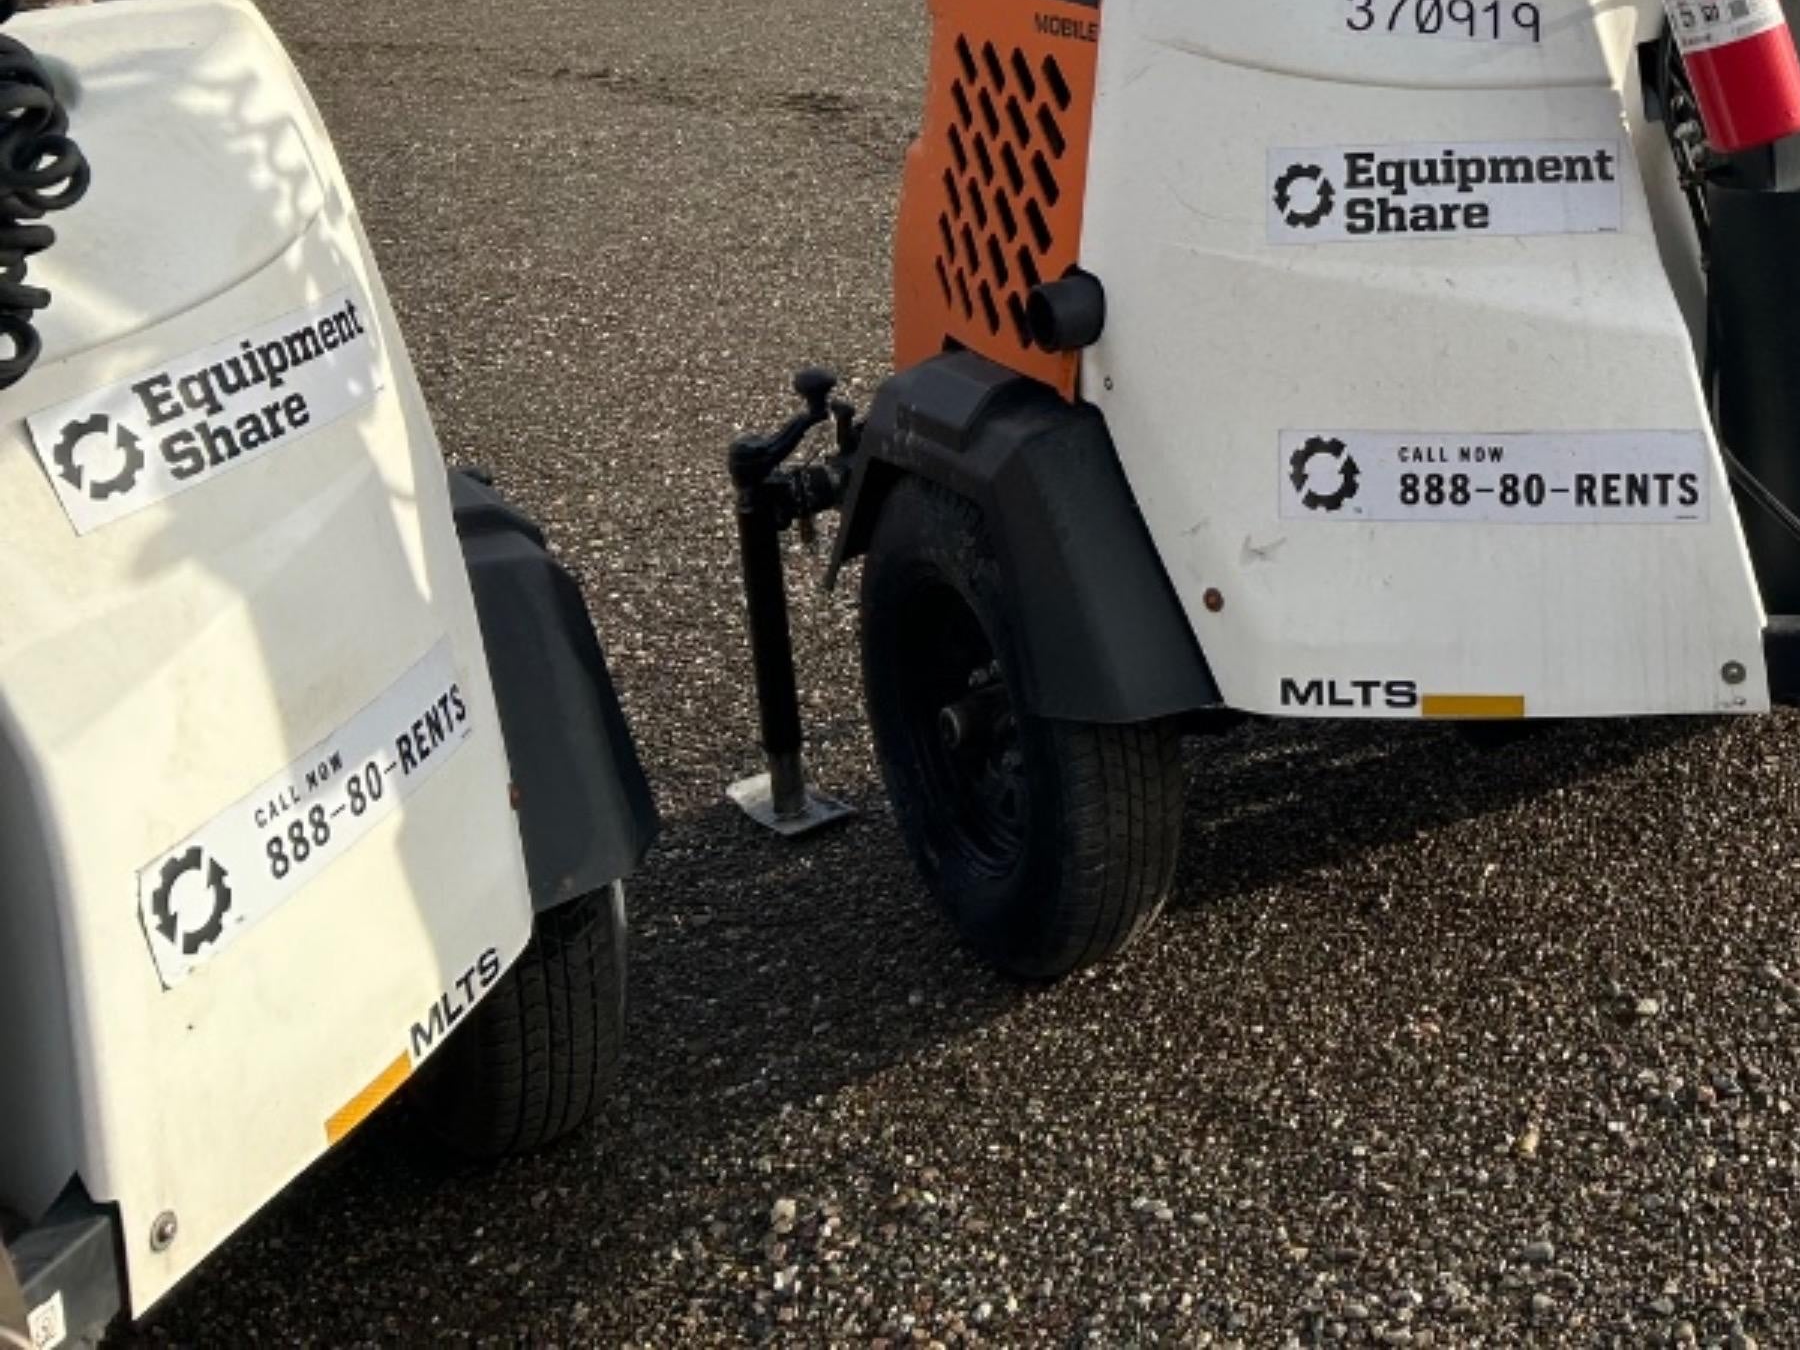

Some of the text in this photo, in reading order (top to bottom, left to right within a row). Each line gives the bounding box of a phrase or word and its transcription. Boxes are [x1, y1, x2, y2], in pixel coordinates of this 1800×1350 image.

[1034, 11, 1099, 43] MOBILE
[1344, 150, 1615, 196] Equipment
[1345, 197, 1490, 234] Share
[131, 299, 364, 427] Equipment
[159, 392, 310, 481] Share
[1399, 446, 1505, 463] CALL NOW
[1399, 473, 1699, 507] 888-80-RENTS
[1280, 677, 1418, 709] MLTS
[255, 750, 343, 829] CALL NOW
[266, 682, 467, 880] 888-80-RENTS
[410, 947, 500, 1057] MLTS
